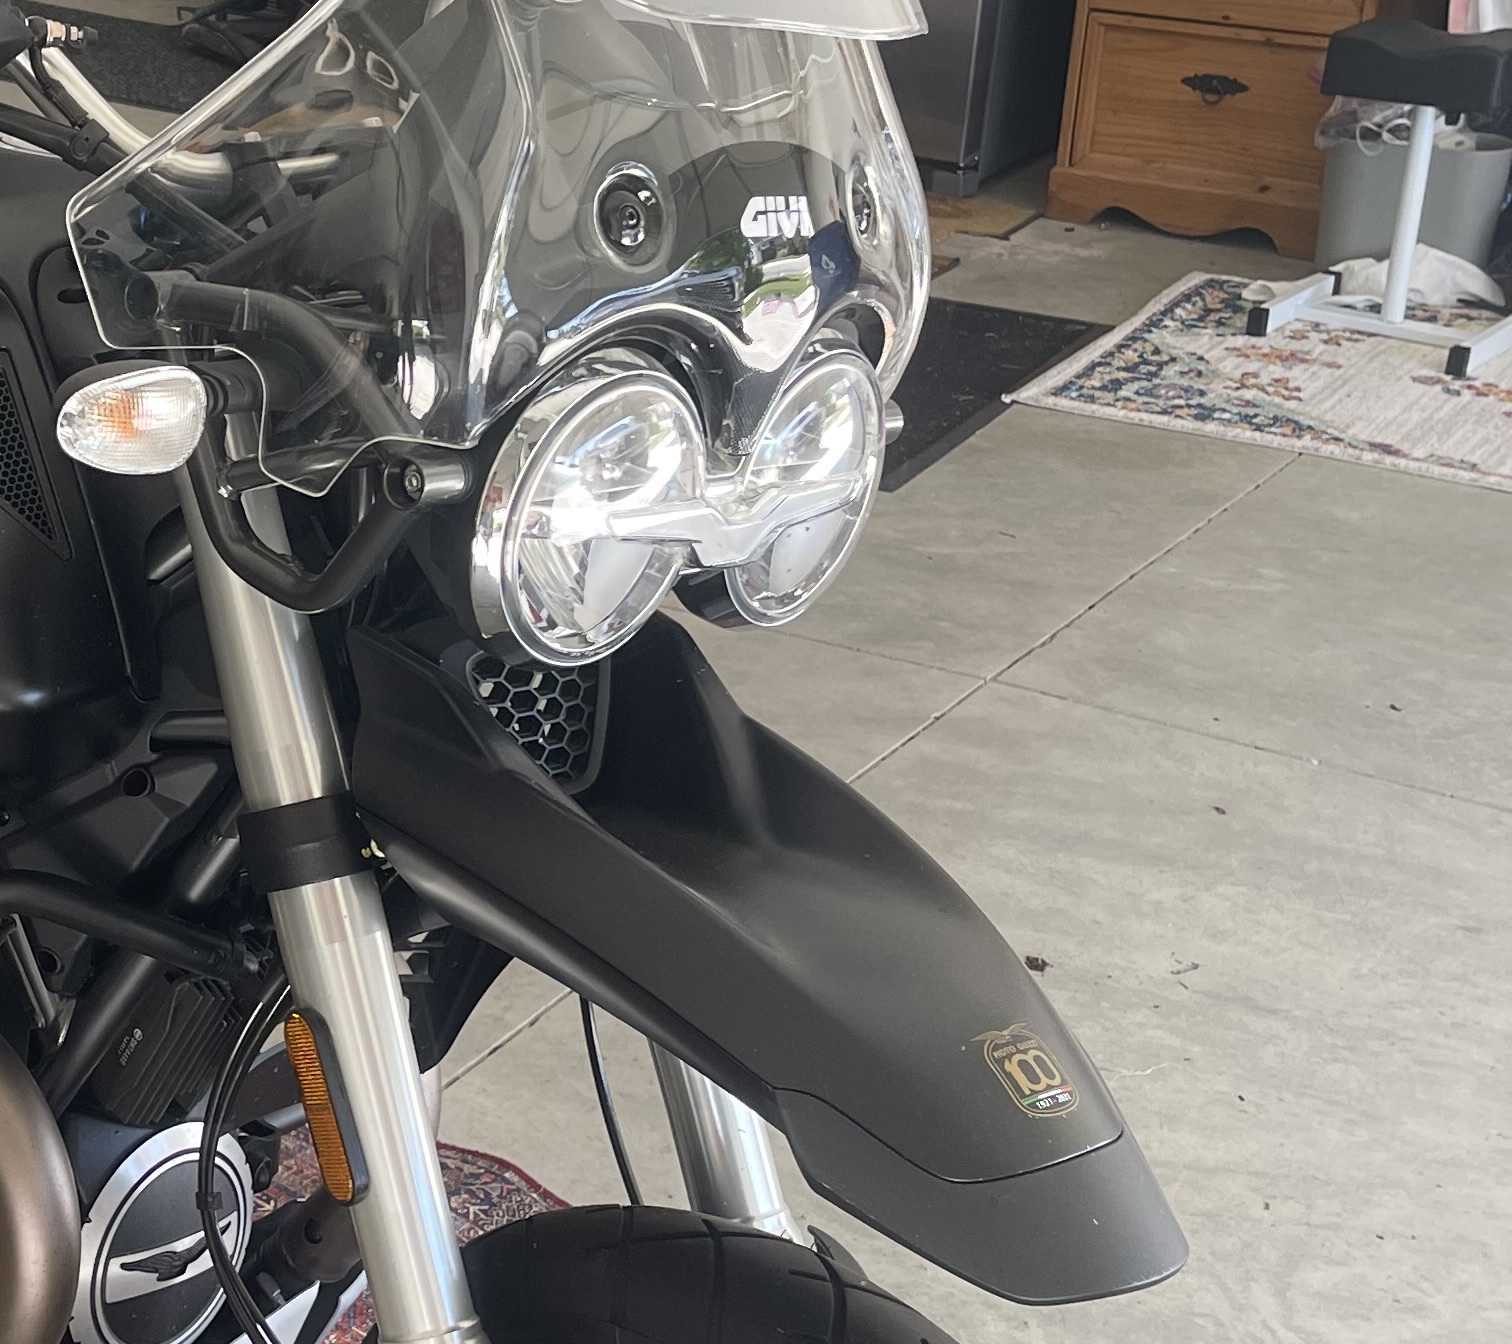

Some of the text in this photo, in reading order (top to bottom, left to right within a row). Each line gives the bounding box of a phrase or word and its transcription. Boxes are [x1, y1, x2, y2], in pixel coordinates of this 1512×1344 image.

[740, 195, 815, 238] GIVI
[992, 1045, 1017, 1058] MOTO
[1004, 1049, 1062, 1095] 100
